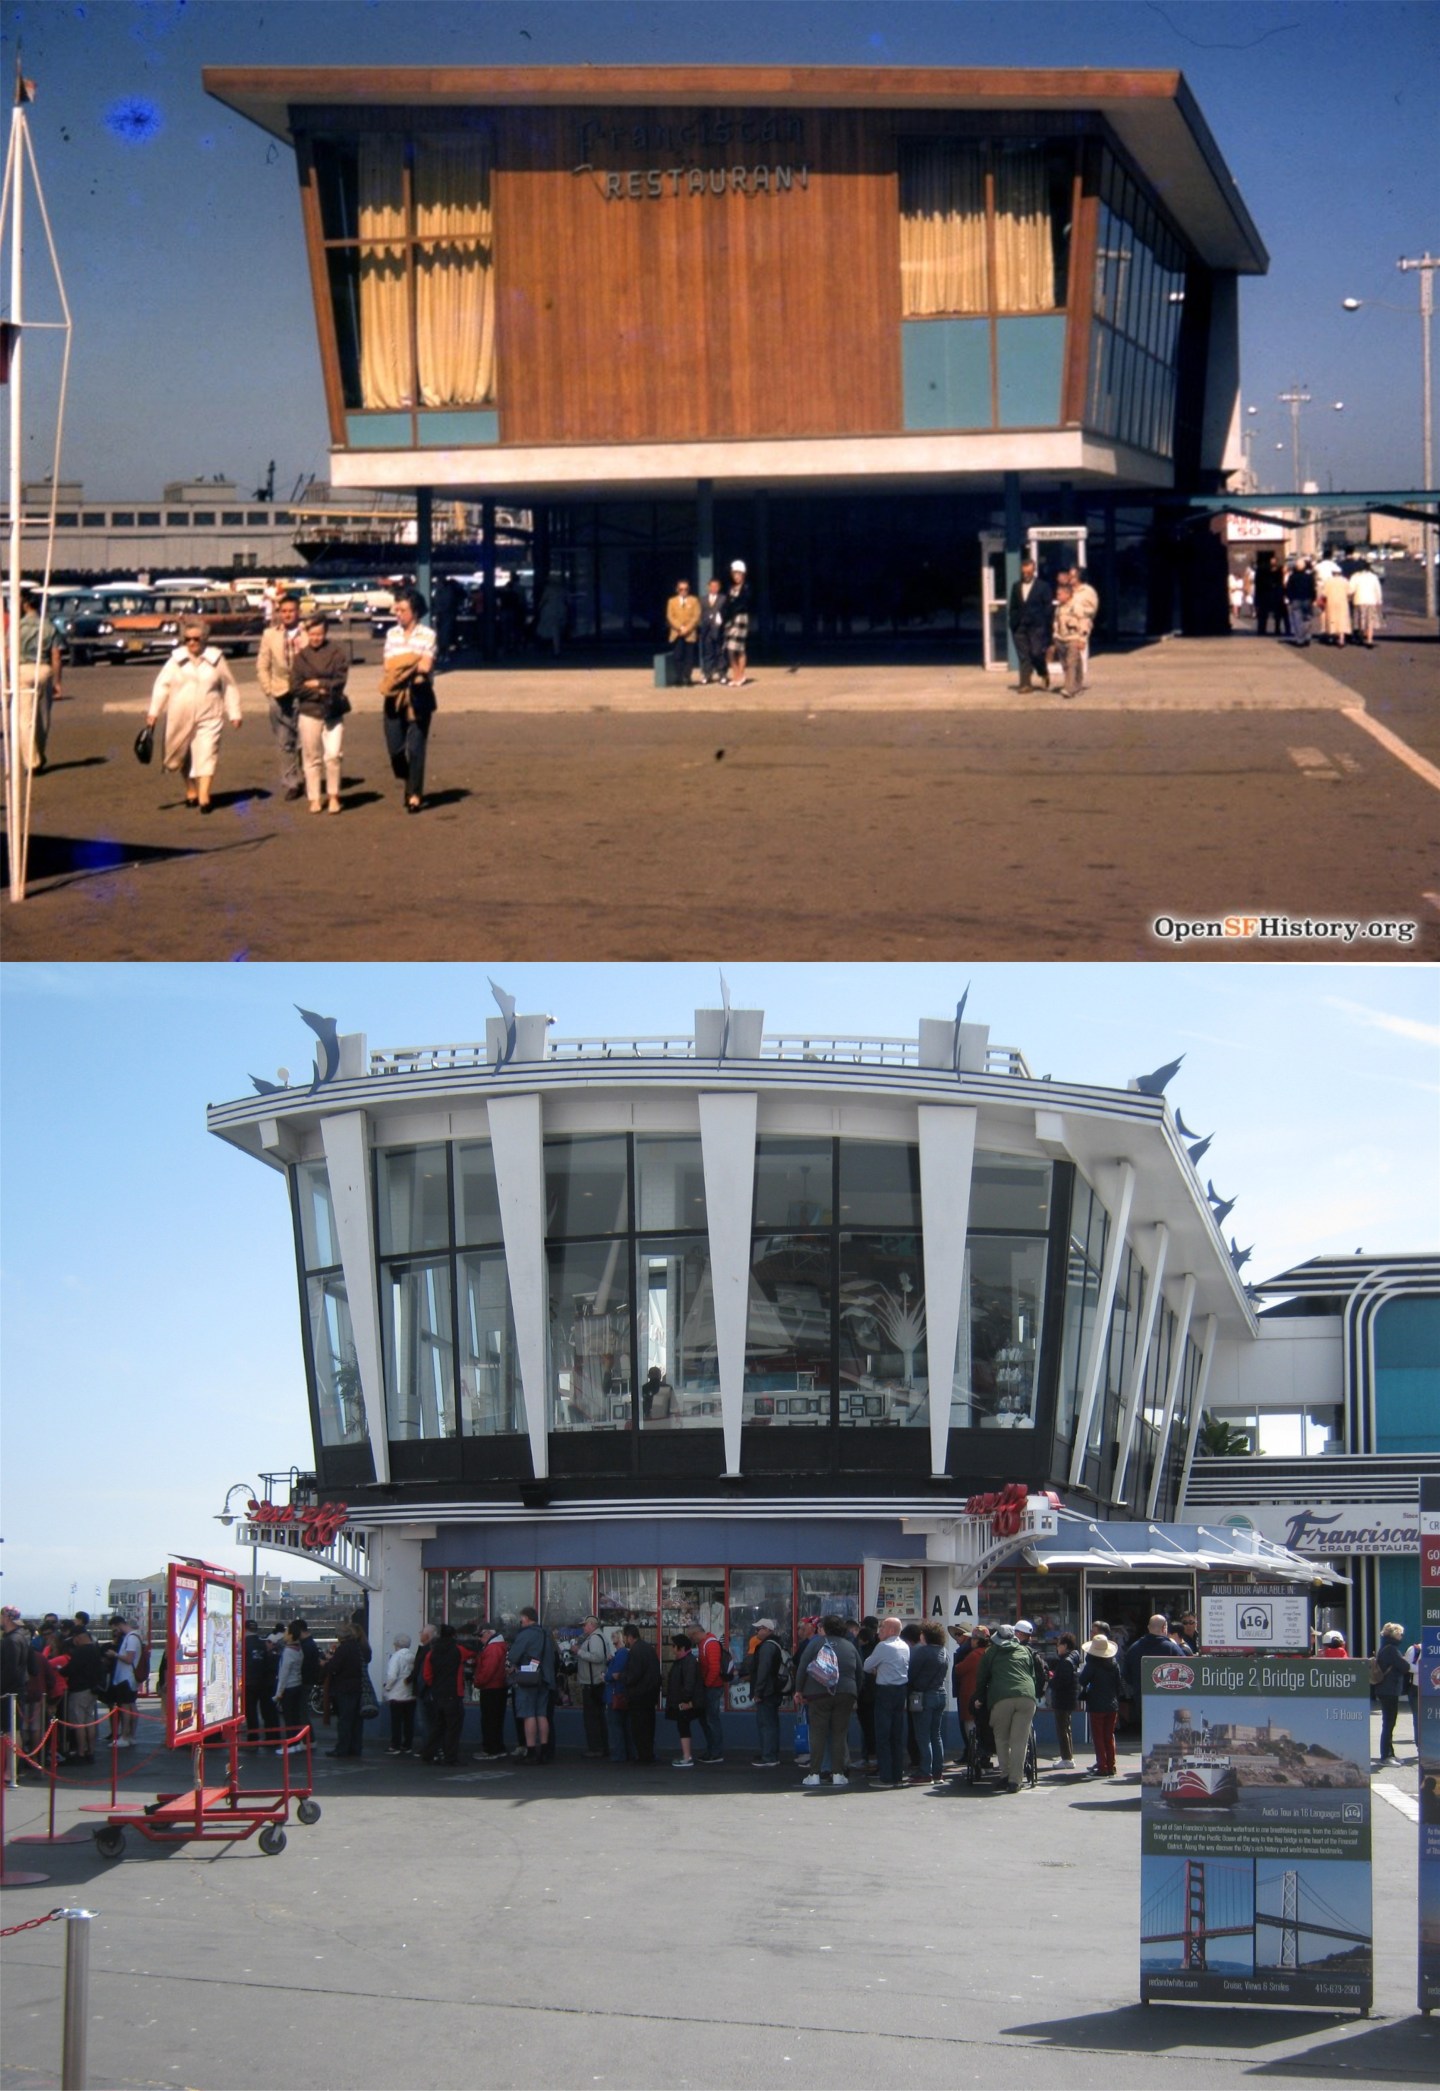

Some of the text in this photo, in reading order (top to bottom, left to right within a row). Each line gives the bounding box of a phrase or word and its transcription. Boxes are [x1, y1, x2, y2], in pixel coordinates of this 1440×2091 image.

[1356, 1544, 1418, 1552] RESTAURA
[1211, 1585, 1232, 1595] AUDIO
[1233, 1585, 1251, 1595] TOUR
[1252, 1585, 1286, 1595] AVAILABLE
[1246, 1615, 1262, 1627] 16
[1201, 1667, 1244, 1690] Bridge
[1248, 1668, 1257, 1687] 2
[1262, 1667, 1305, 1691] Bridge
[1326, 1708, 1363, 1720] 1.5 Hours
[1262, 1807, 1341, 1819] Audio Tour in 16 Languages
[1148, 1979, 1198, 1988] redandwhite.com
[1244, 1981, 1262, 1990] Views
[1269, 1981, 1290, 1992] Smiles
[1315, 1984, 1361, 1995] 415-673-2900
